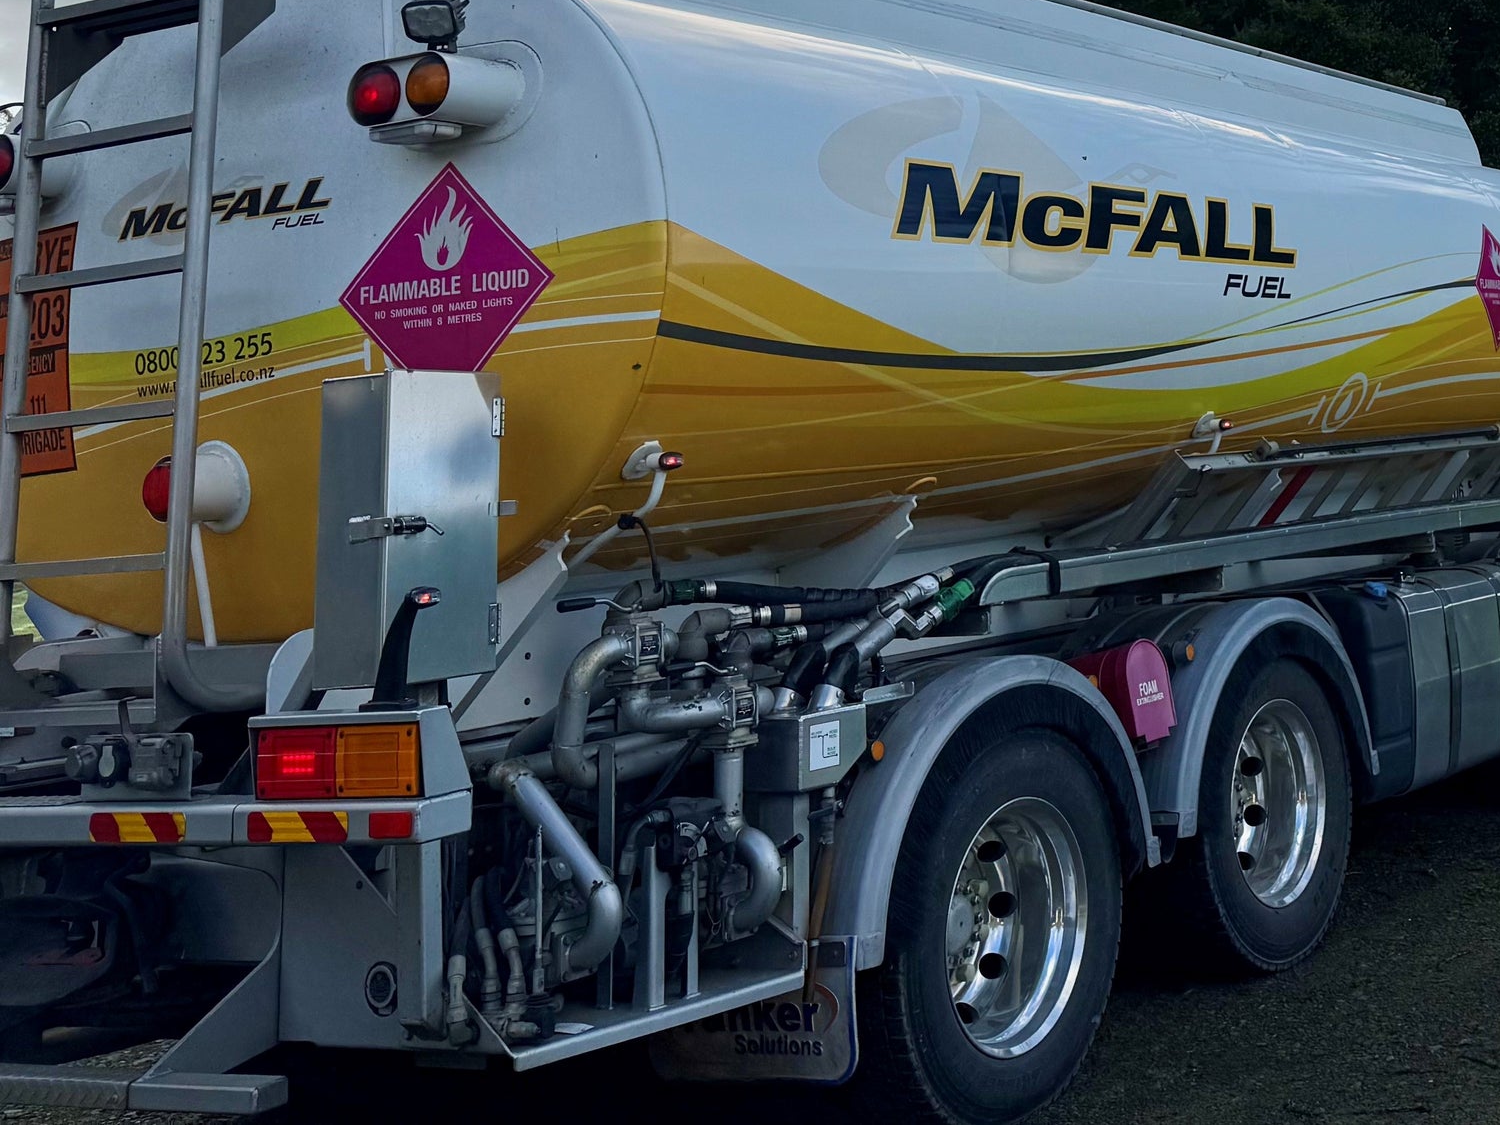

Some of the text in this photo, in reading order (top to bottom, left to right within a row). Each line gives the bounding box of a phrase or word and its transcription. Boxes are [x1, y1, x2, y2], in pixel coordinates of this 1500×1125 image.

[272, 213, 324, 230] FUEL
[891, 157, 1297, 268] McFALL
[360, 269, 530, 305] FLAMMABLE LIQUID
[1223, 273, 1292, 299] FUEL
[375, 297, 513, 320] NO SMOKING OR NAKED LIGHTS
[403, 312, 482, 329] WITHIN 8 METRES
[233, 332, 273, 360] 255
[22, 429, 66, 456] RIGADE
[1139, 679, 1158, 697] FOAM
[685, 1000, 821, 1033] anker
[734, 1033, 824, 1057] Solutions
